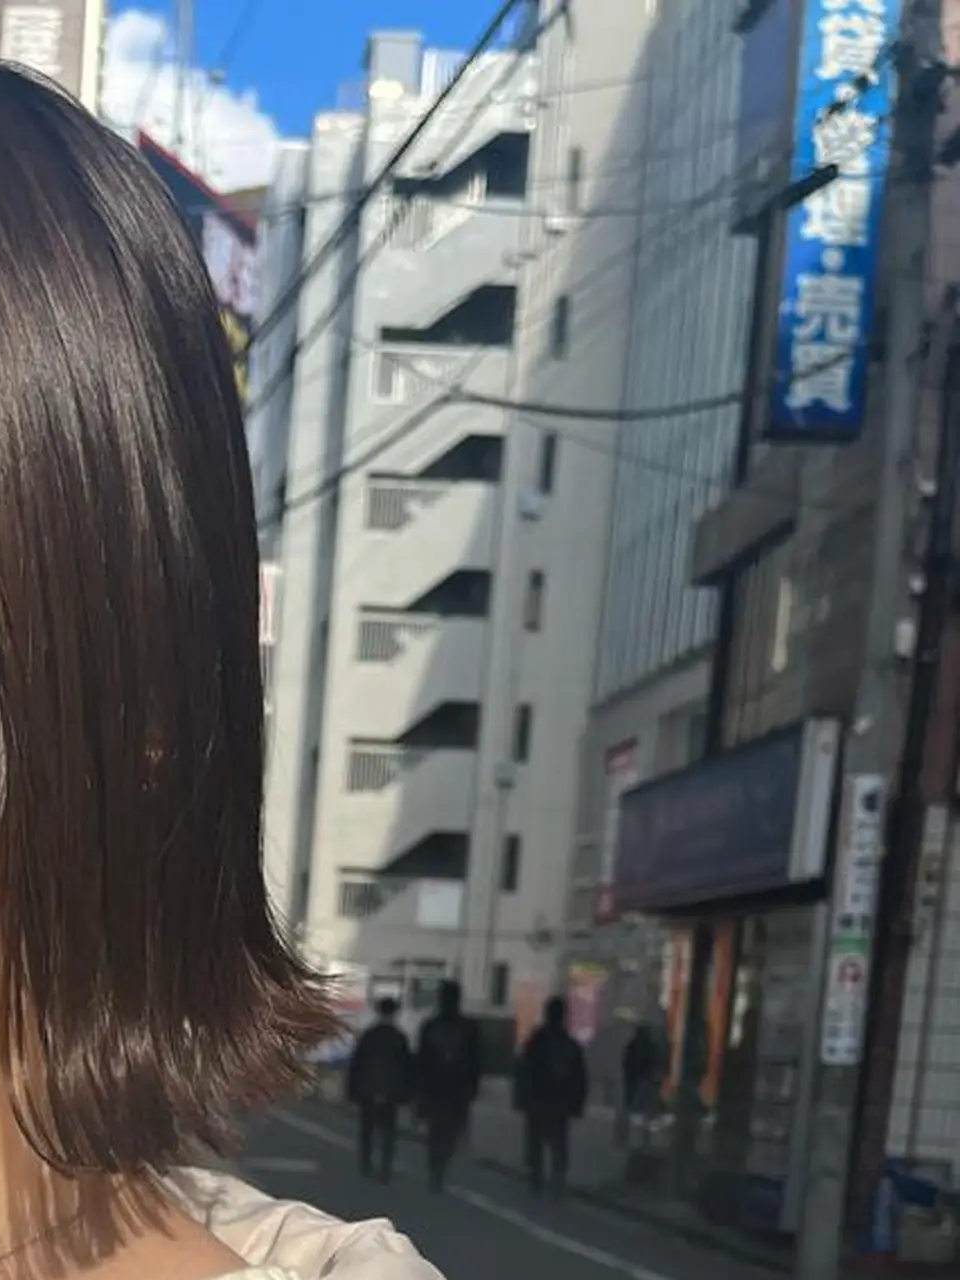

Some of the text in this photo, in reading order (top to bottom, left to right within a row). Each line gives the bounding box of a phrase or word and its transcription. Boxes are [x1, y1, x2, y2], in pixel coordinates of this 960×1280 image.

[785, 0, 887, 412] 貸・管理・売買
